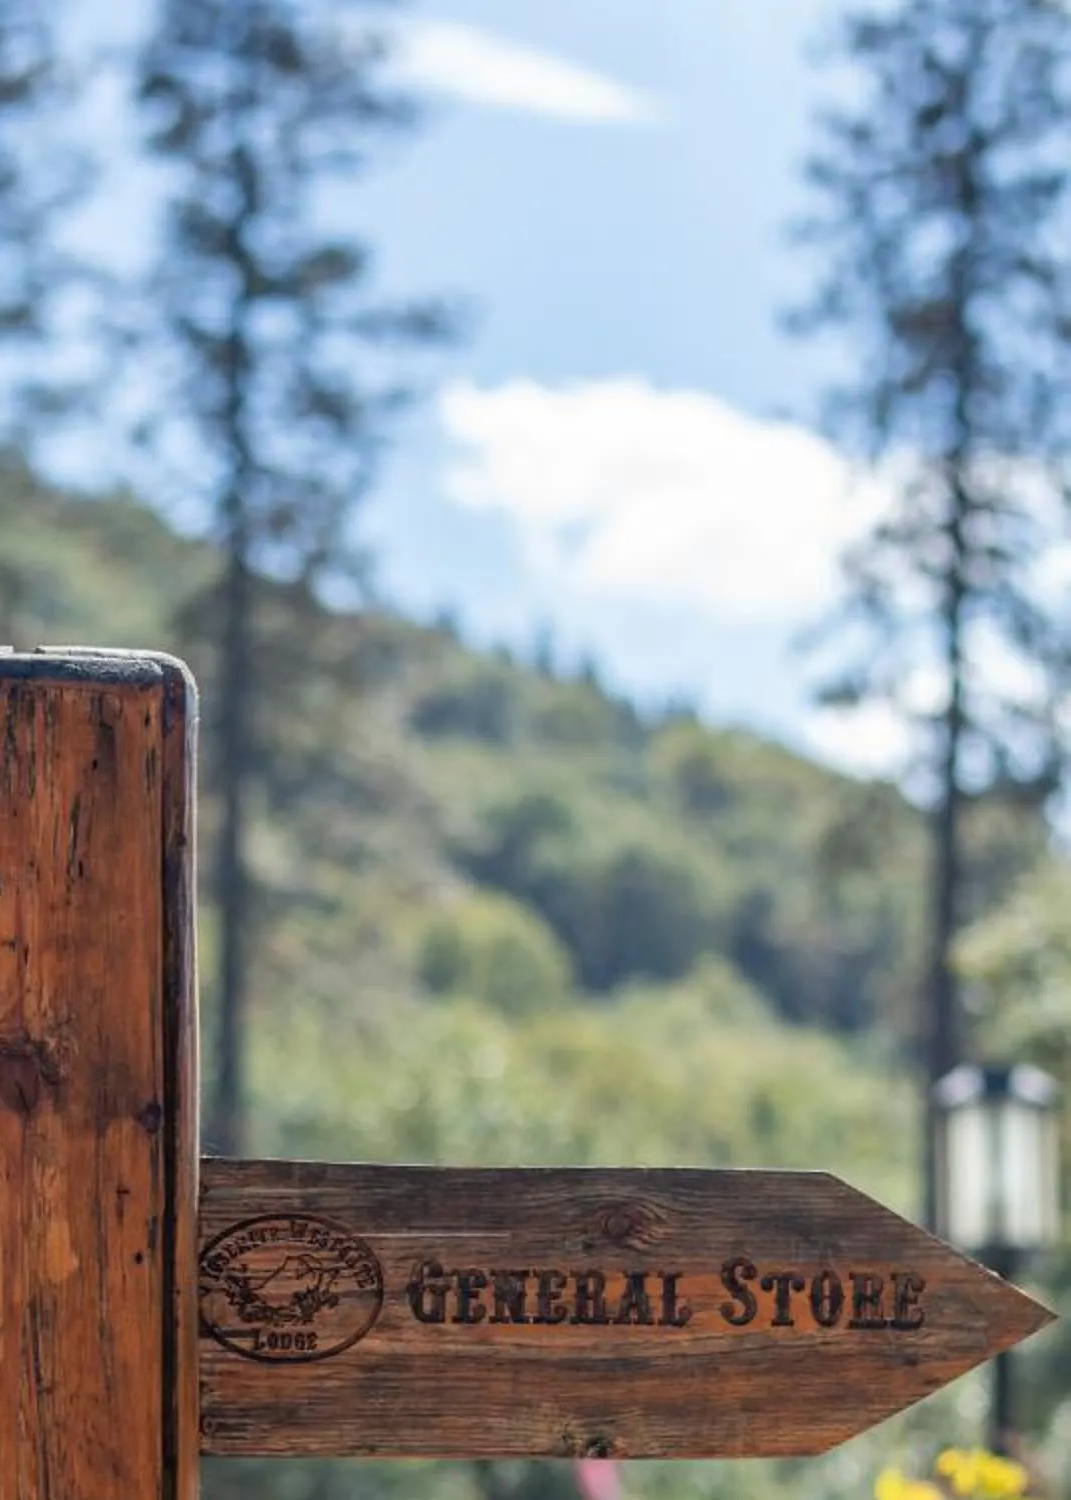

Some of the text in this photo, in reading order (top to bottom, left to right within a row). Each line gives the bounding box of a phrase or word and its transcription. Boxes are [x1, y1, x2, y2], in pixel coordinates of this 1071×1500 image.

[406, 1254, 925, 1331] GENERAL STORE
[252, 1328, 319, 1350] LODGE
